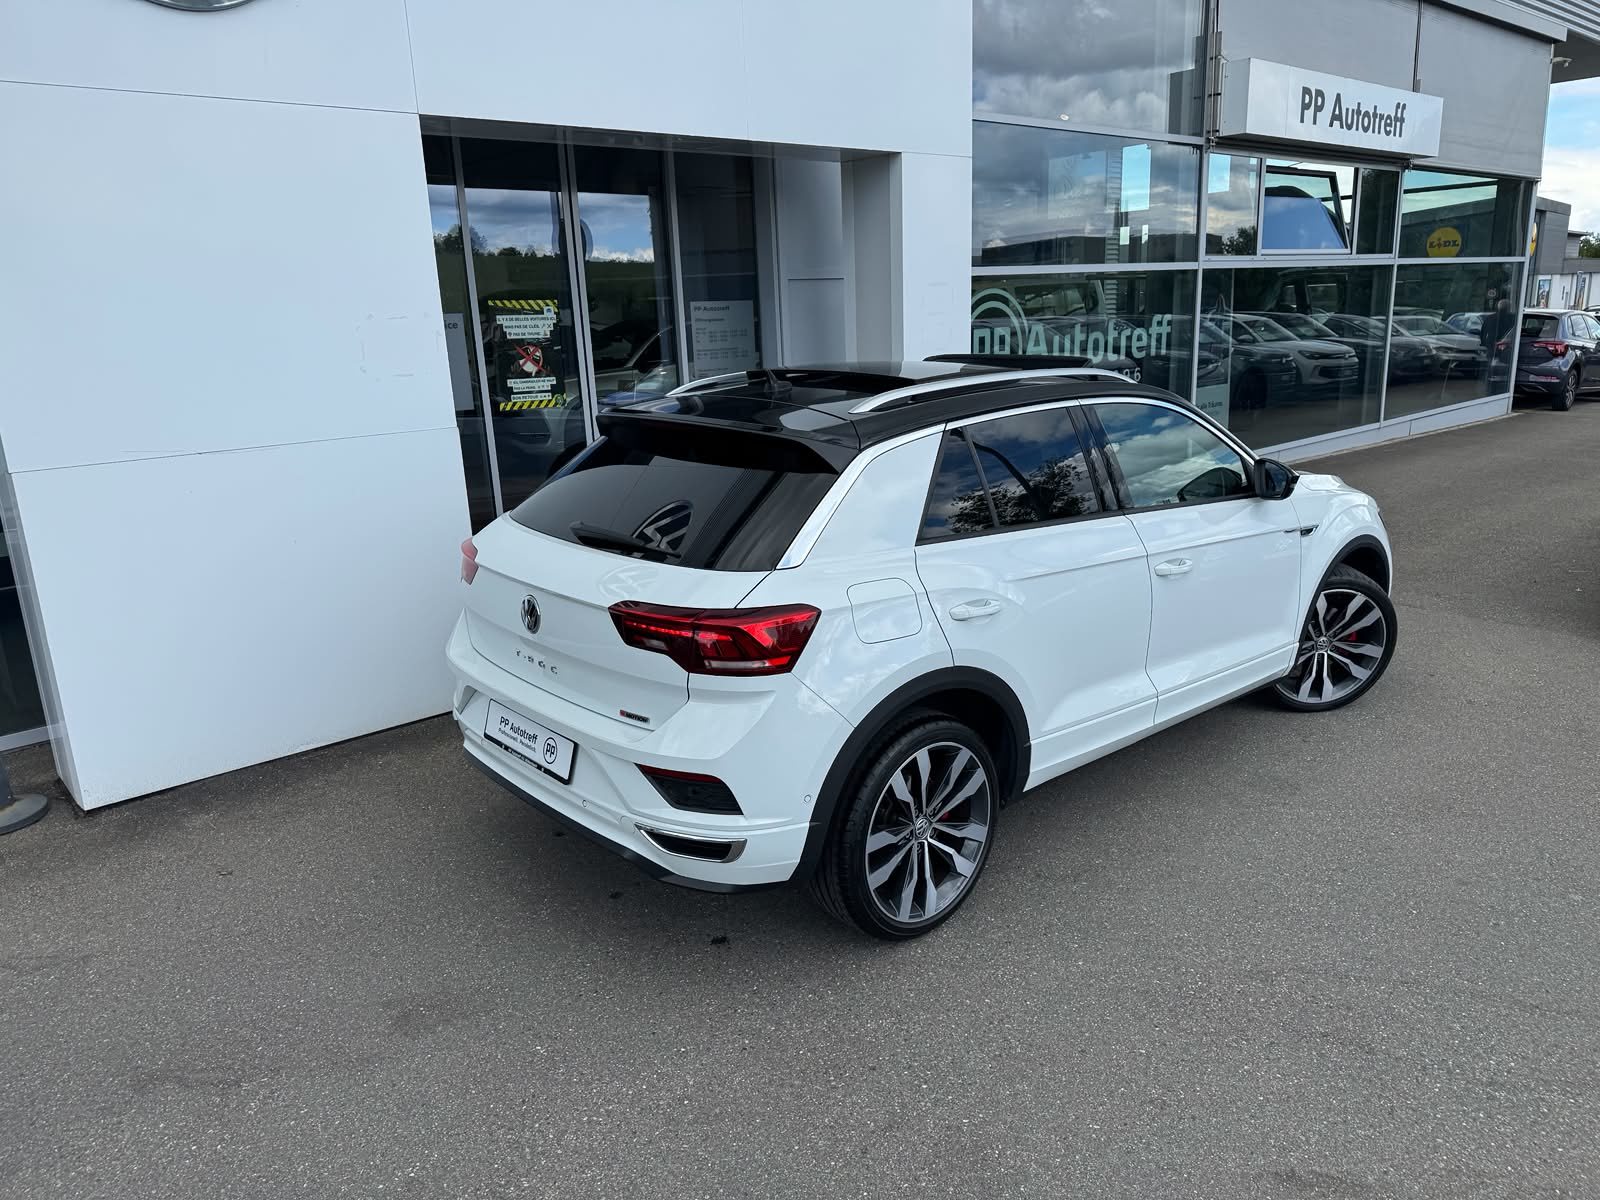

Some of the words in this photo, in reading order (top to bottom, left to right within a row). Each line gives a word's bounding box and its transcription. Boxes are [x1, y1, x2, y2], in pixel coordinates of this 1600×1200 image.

[1300, 86, 1326, 125] PP
[1329, 92, 1407, 138] Autotreff
[1025, 314, 1172, 364] Autotreff
[499, 716, 510, 728] PP
[509, 722, 539, 745] Autotreff
[545, 742, 556, 758] PP
